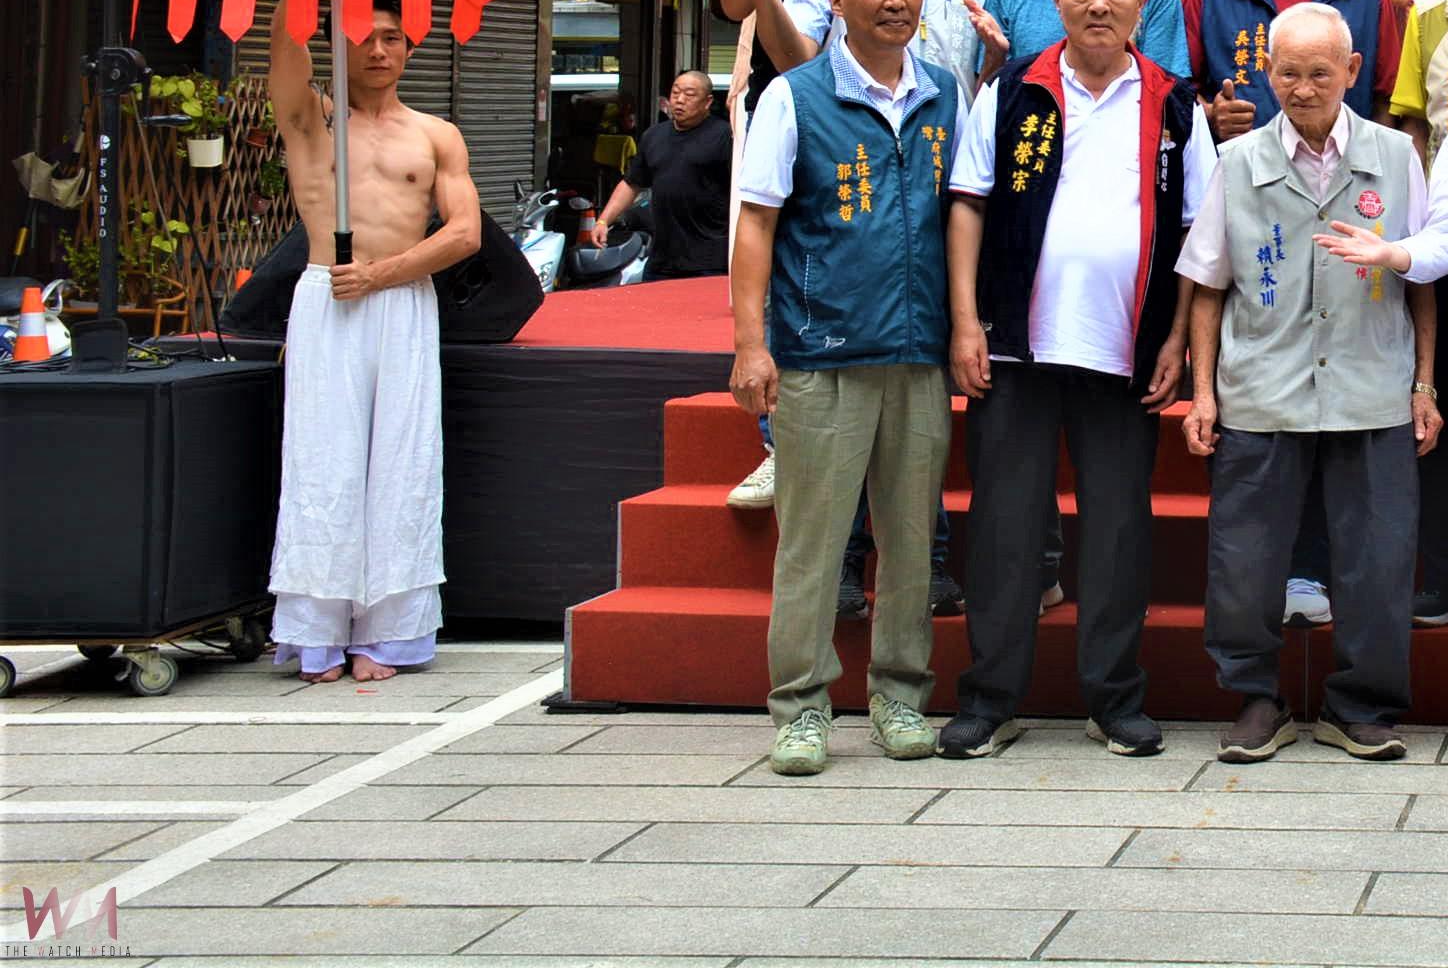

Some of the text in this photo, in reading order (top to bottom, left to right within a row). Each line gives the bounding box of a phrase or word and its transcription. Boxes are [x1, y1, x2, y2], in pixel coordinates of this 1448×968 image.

[856, 143, 873, 213] 主任委員
[1012, 113, 1040, 193] 李榮宗
[99, 183, 108, 238] AUDIO
